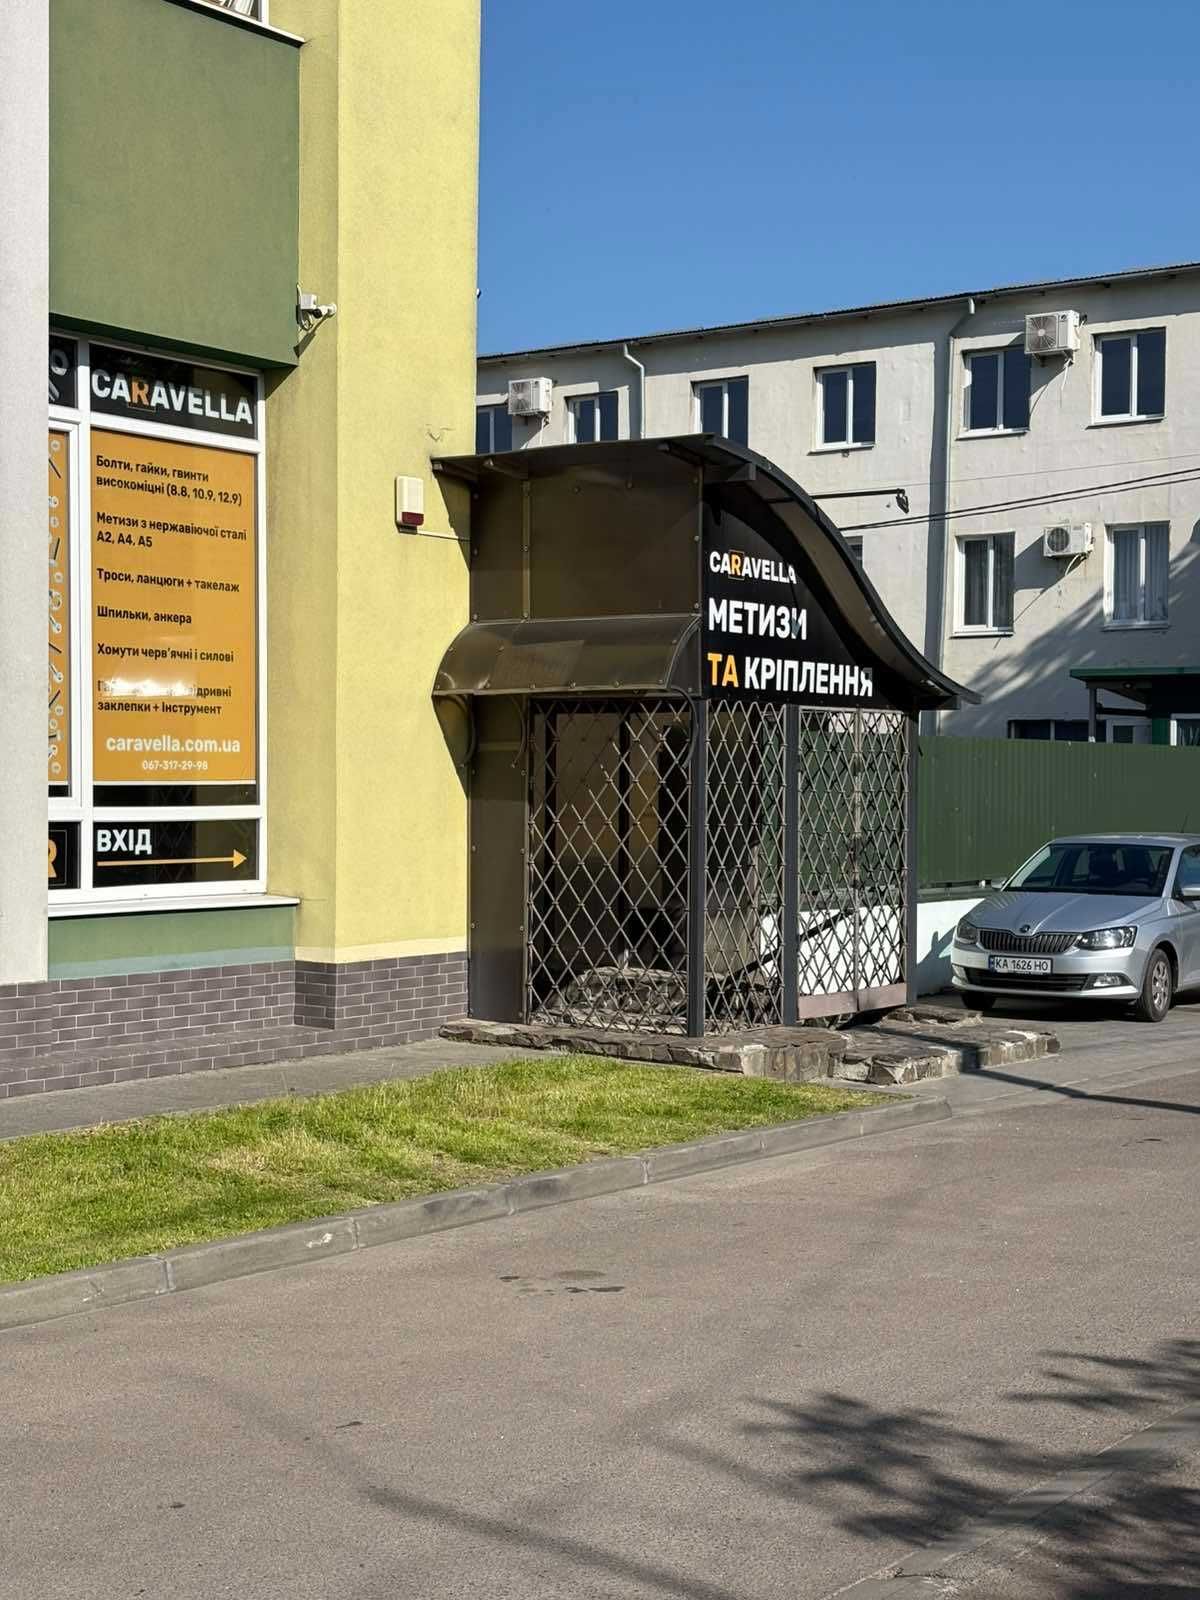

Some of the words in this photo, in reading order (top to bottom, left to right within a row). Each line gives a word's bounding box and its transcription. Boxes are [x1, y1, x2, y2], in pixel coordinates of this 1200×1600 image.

[92, 370, 253, 424] CARAVELLA
[96, 455, 133, 473] Болти,
[136, 461, 170, 477] гайки,
[172, 468, 209, 482] гвинти
[96, 476, 165, 495] високоміцні
[167, 485, 191, 499] (8.8,
[192, 487, 216, 502] 10.9,
[217, 491, 242, 506] 12.9)
[96, 512, 138, 528] Метизи
[140, 520, 147, 529] з
[149, 519, 219, 537] нержавіючої
[220, 528, 247, 541] сталі
[96, 568, 134, 583] Троси,
[136, 574, 184, 589] ланцюги
[195, 580, 240, 593] такелаж
[709, 551, 797, 585] CARAVELLA
[97, 605, 151, 622] Шпильки,
[153, 612, 192, 626] анкера
[708, 597, 807, 641] МЕТИЗИ
[97, 643, 139, 658] Хомути
[199, 650, 234, 662] силові
[707, 653, 739, 688] ТА
[744, 656, 873, 697] КРІПЛЕННЯ
[97, 701, 151, 713] заклепки
[106, 735, 240, 753] caravella.com.ua
[141, 760, 208, 770] 067-317-29-98
[97, 829, 152, 855] ВХІД
[1011, 960, 1032, 970] 1626
